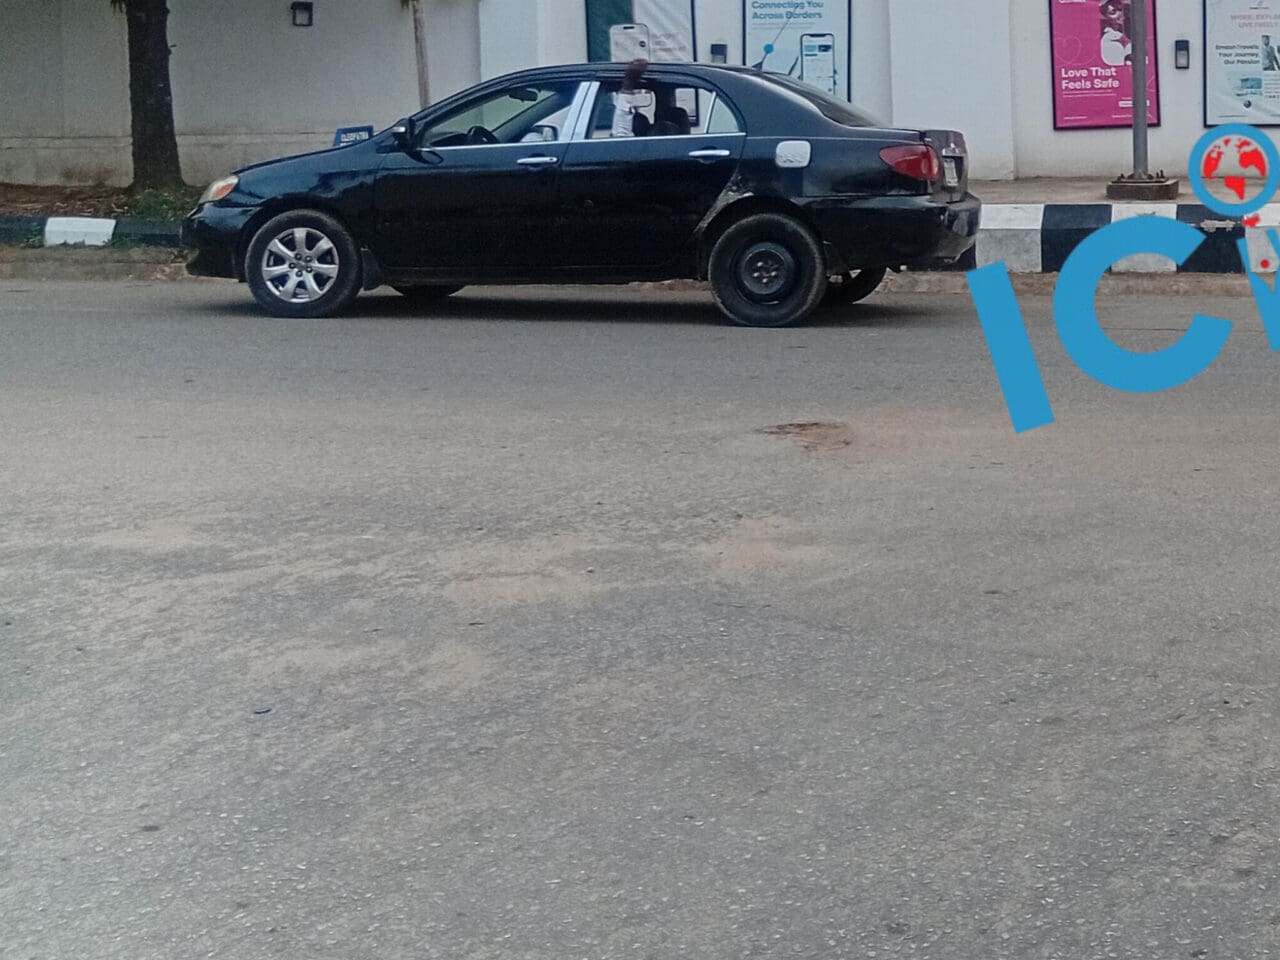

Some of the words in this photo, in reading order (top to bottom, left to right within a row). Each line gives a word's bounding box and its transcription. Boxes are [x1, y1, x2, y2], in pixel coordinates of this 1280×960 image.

[752, 0, 805, 10] Connecting
[806, 0, 824, 9] You
[752, 12, 784, 20] Across
[785, 10, 823, 19] Borders
[1061, 68, 1088, 78] Love
[1090, 66, 1117, 77] That
[1062, 79, 1092, 90] Feels
[1093, 78, 1120, 88] Safe
